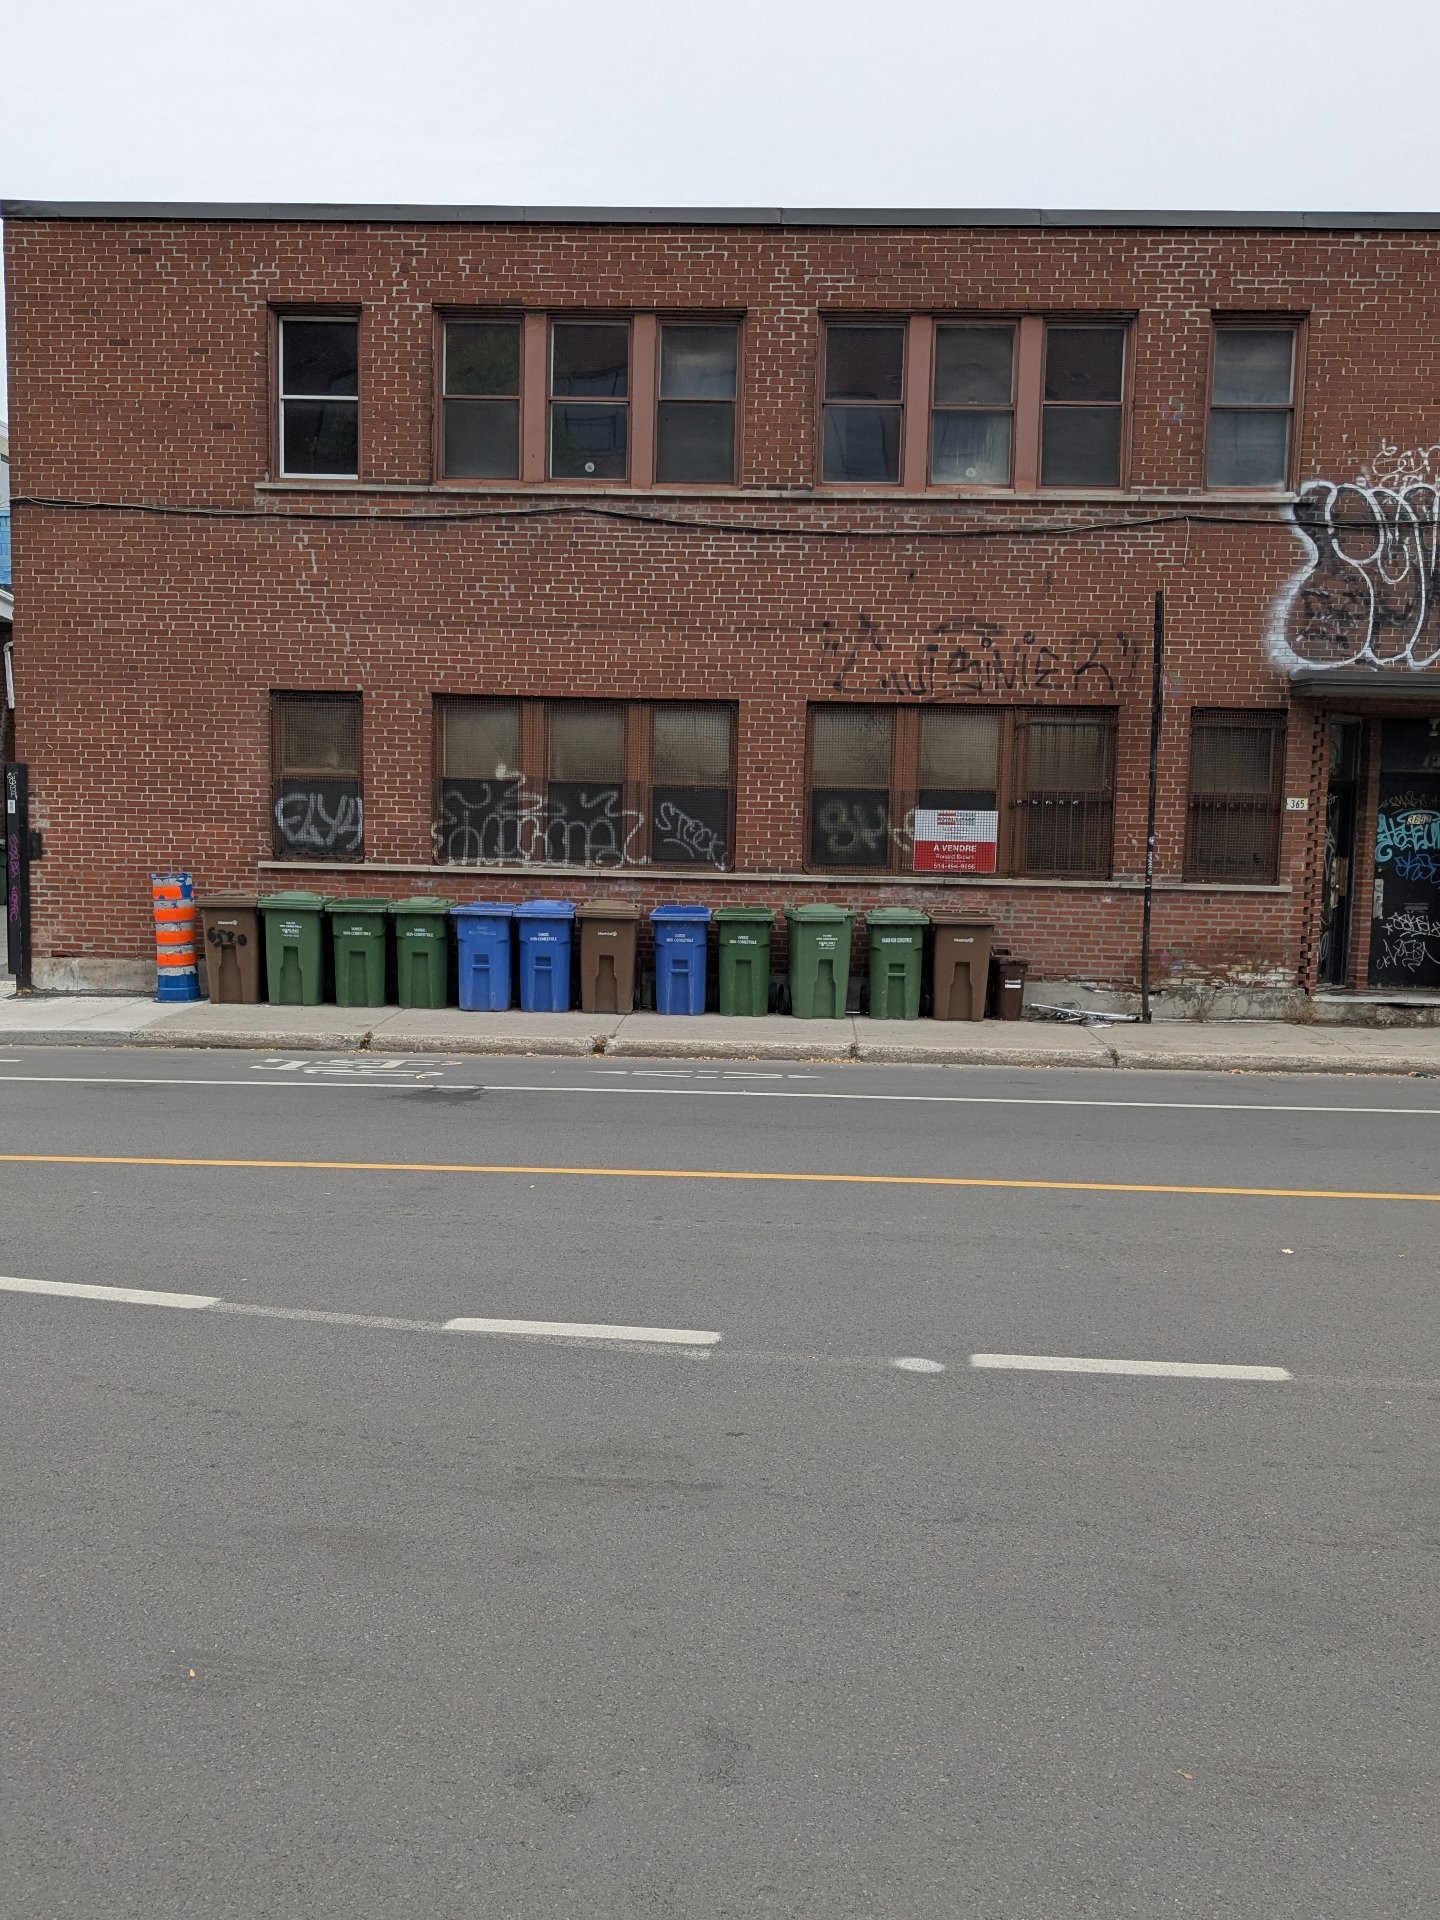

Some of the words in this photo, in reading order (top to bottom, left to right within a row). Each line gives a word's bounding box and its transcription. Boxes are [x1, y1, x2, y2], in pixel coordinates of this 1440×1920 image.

[1290, 800, 1304, 808] 365
[934, 842, 940, 852] À
[942, 844, 976, 852] VENDRE
